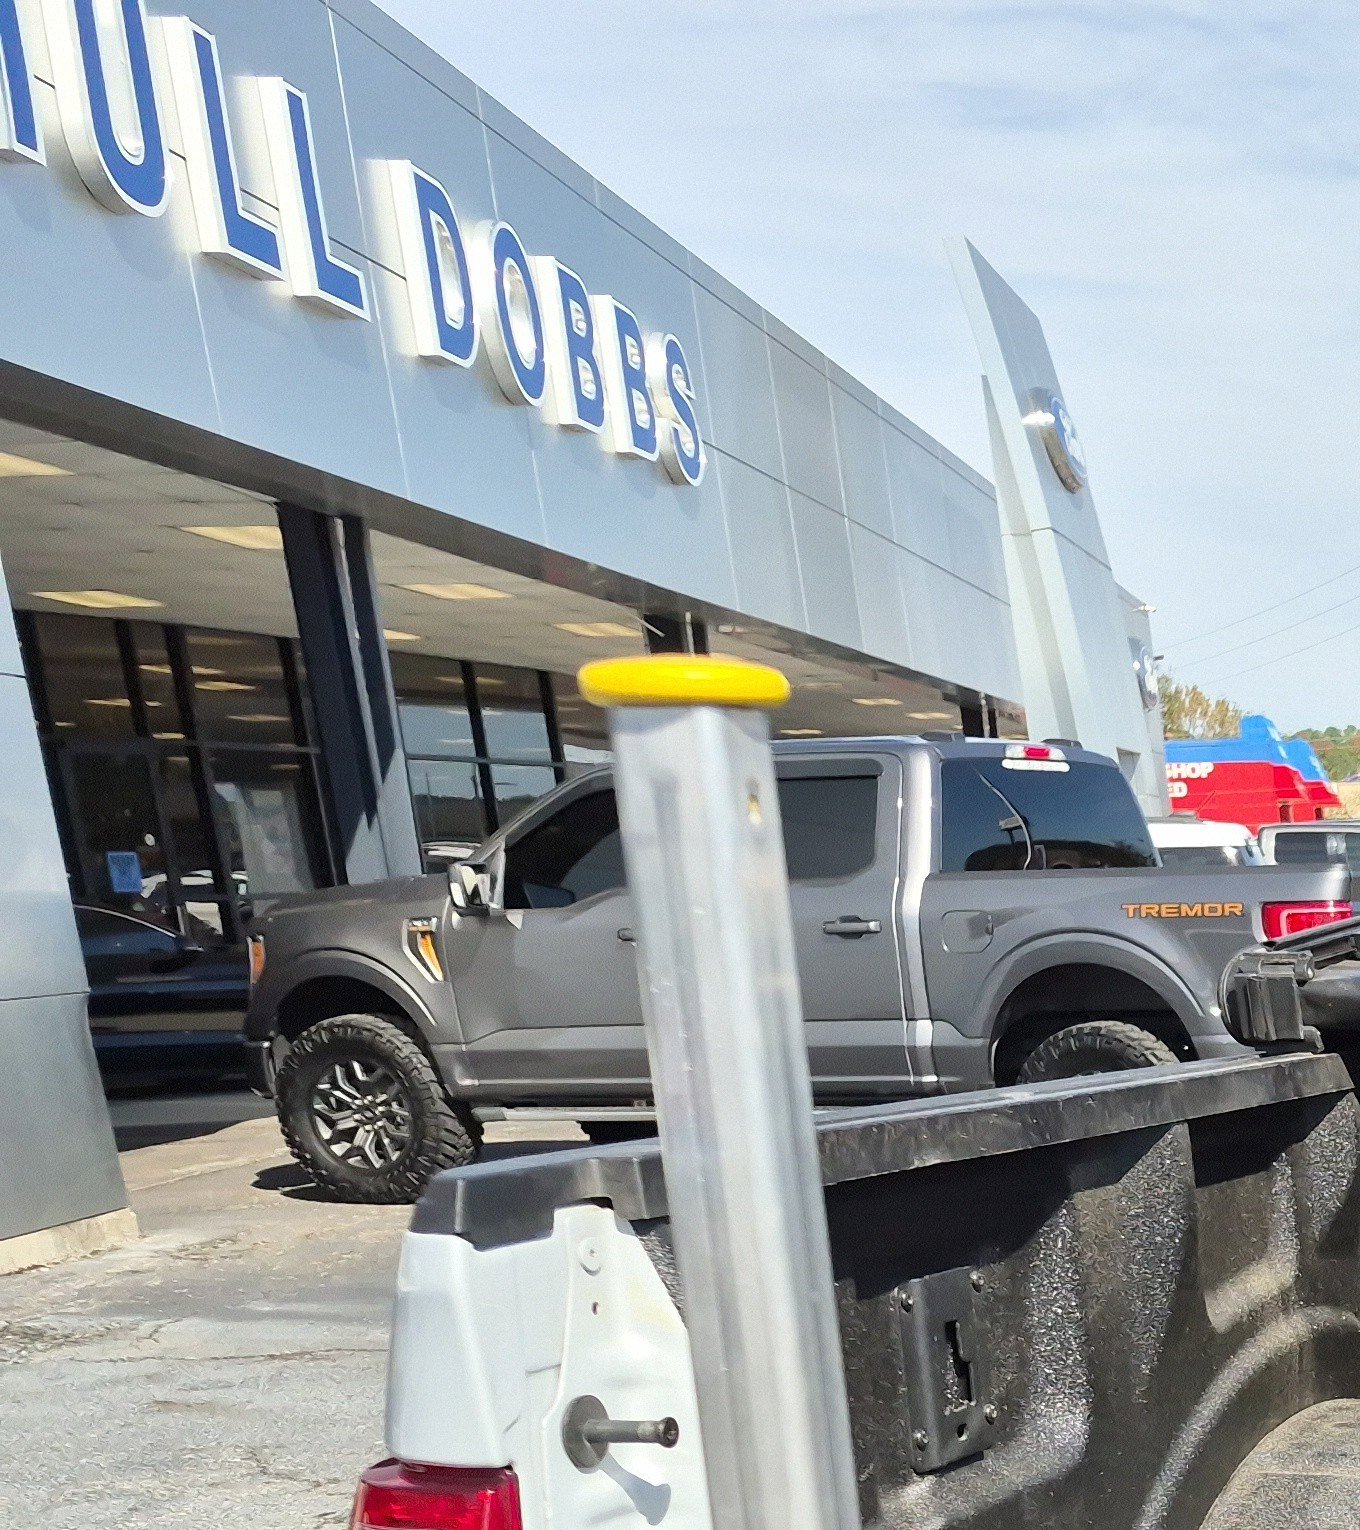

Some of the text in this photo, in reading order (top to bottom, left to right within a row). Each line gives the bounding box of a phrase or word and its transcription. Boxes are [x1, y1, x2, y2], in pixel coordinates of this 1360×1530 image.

[0, 0, 707, 487] ULL DOBBS
[1121, 902, 1244, 918] TREMOR
